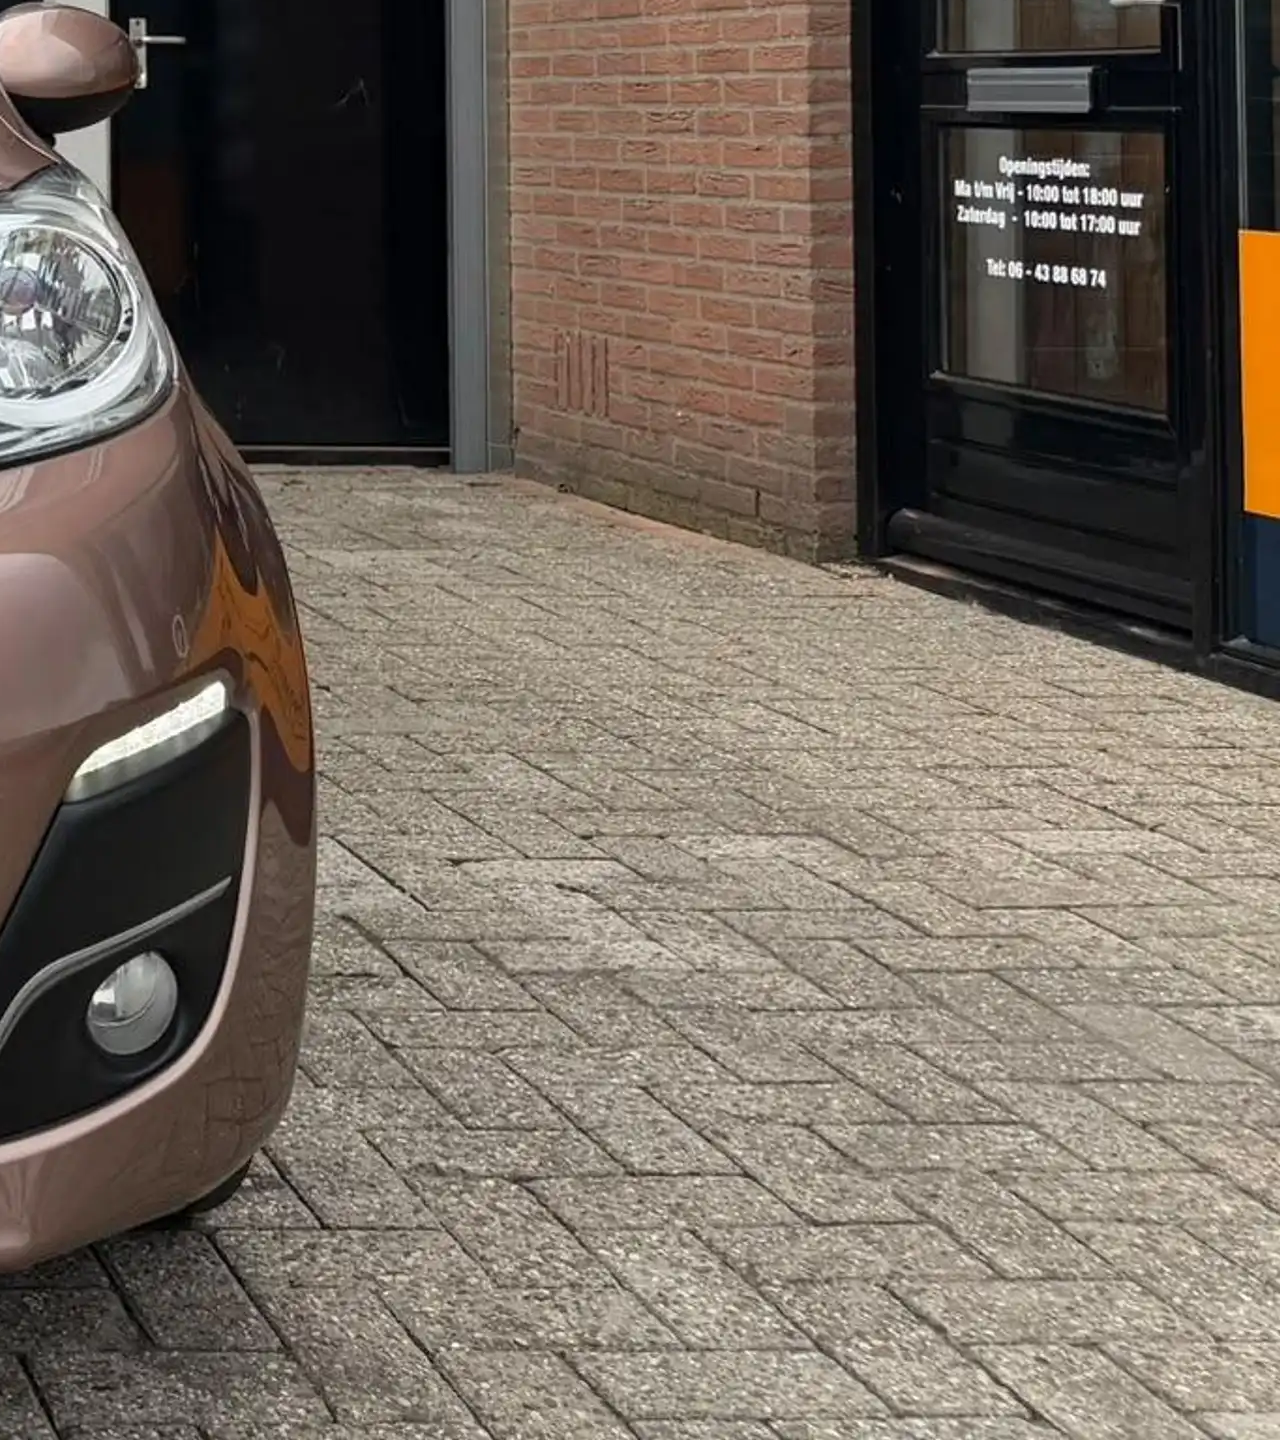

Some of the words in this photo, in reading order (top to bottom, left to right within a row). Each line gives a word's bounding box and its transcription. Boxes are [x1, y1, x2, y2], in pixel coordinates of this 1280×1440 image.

[998, 155, 1091, 180] Openingstijden:
[1026, 183, 1060, 203] 10:00
[1062, 185, 1080, 205] tot
[1082, 186, 1119, 207] 18:00
[1120, 192, 1144, 209] uur
[956, 204, 1006, 229] Zaterdag
[1024, 209, 1058, 230] 10:00
[1059, 211, 1077, 231] tot
[1079, 213, 1117, 234] 17:00
[1118, 220, 1142, 236] uur
[986, 258, 1007, 278] Tel:
[1007, 260, 1023, 279] 06
[1089, 268, 1107, 289] 74
